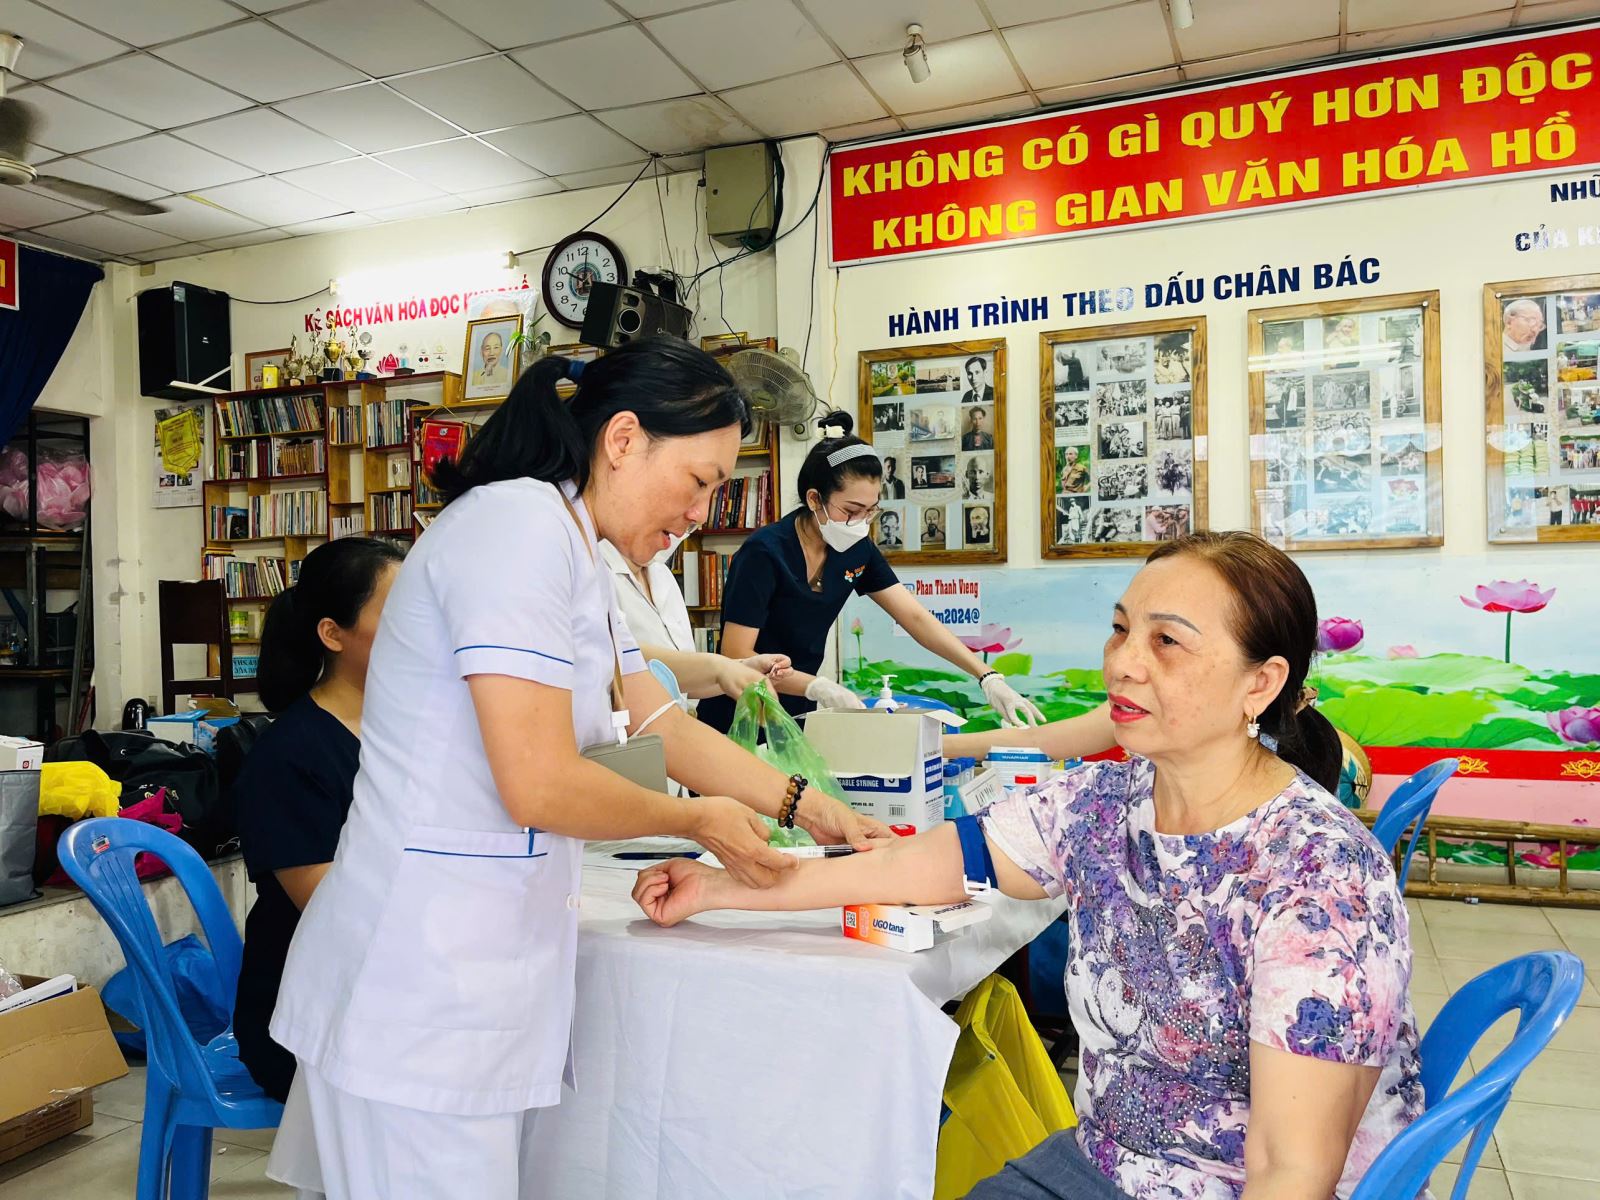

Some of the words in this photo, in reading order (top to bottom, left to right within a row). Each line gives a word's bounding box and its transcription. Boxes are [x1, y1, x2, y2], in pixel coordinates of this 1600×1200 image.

[843, 145, 1004, 197] KHÔNG
[1022, 119, 1089, 171] CÓ
[1108, 112, 1161, 158] GÌ
[1180, 90, 1292, 149] QUÝ
[1313, 73, 1439, 126] HƠN
[1460, 52, 1593, 105] ĐỘC
[873, 199, 1037, 250] KHÔNG
[1055, 178, 1183, 227] GIAN
[1202, 158, 1321, 206] VĂN
[1342, 136, 1470, 187] HÓA
[1490, 110, 1578, 168] HỒ
[577, 246, 589, 256] 12
[566, 252, 574, 262] 11
[602, 258, 611, 267] 2
[558, 266, 568, 275] 10
[606, 272, 616, 282] 3
[555, 281, 564, 291] 9
[560, 295, 569, 304] 8
[888, 305, 960, 338] HÀNH
[968, 296, 1048, 328] TRÌNH
[1062, 286, 1134, 318] THEO
[1144, 270, 1205, 309] DẤU
[1213, 264, 1300, 300] CHÂN
[1314, 256, 1380, 290] BÁC
[570, 303, 578, 312] 7
[915, 579, 933, 596] Phan
[934, 579, 957, 595] Thanh
